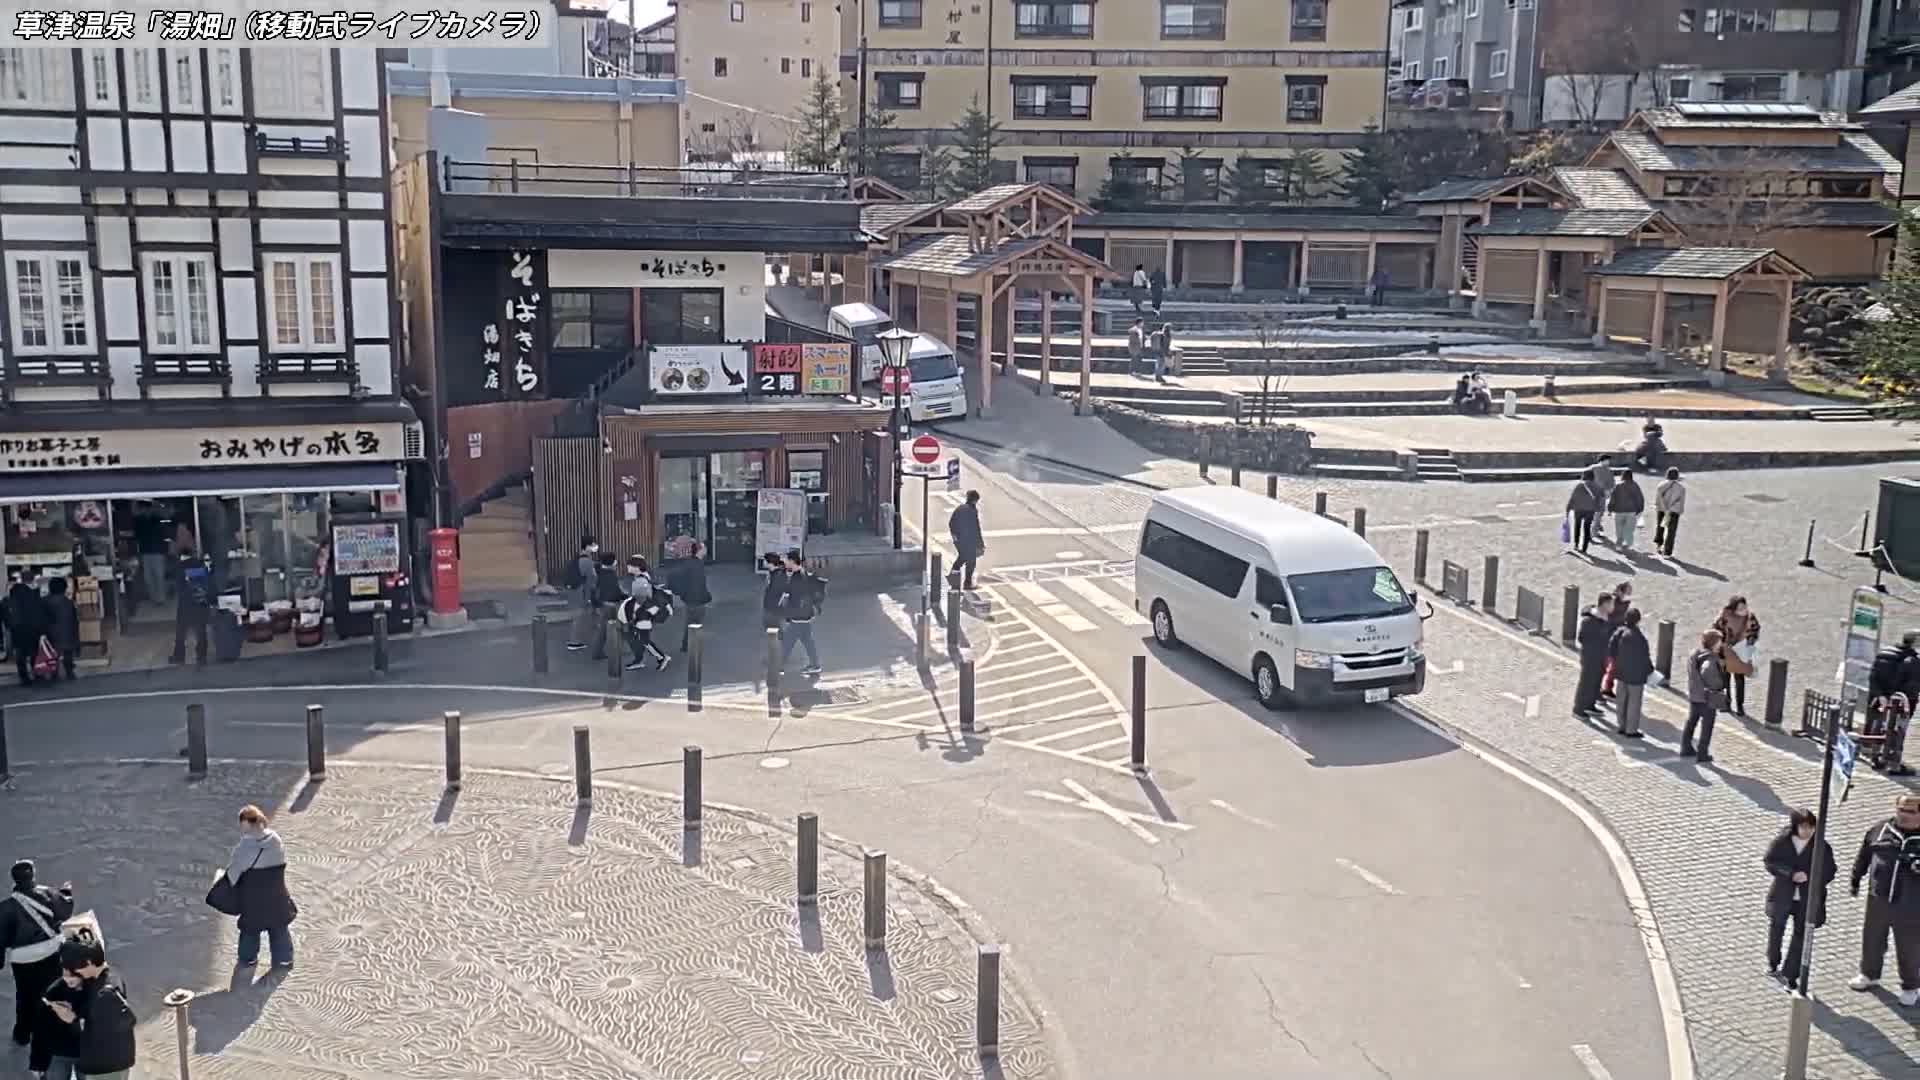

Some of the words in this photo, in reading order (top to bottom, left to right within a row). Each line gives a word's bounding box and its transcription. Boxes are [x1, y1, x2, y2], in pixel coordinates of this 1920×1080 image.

[505, 252, 540, 391] そばきち
[760, 346, 799, 369] 射的
[761, 374, 796, 391] 2階
[200, 430, 379, 459] おみやげの本多
